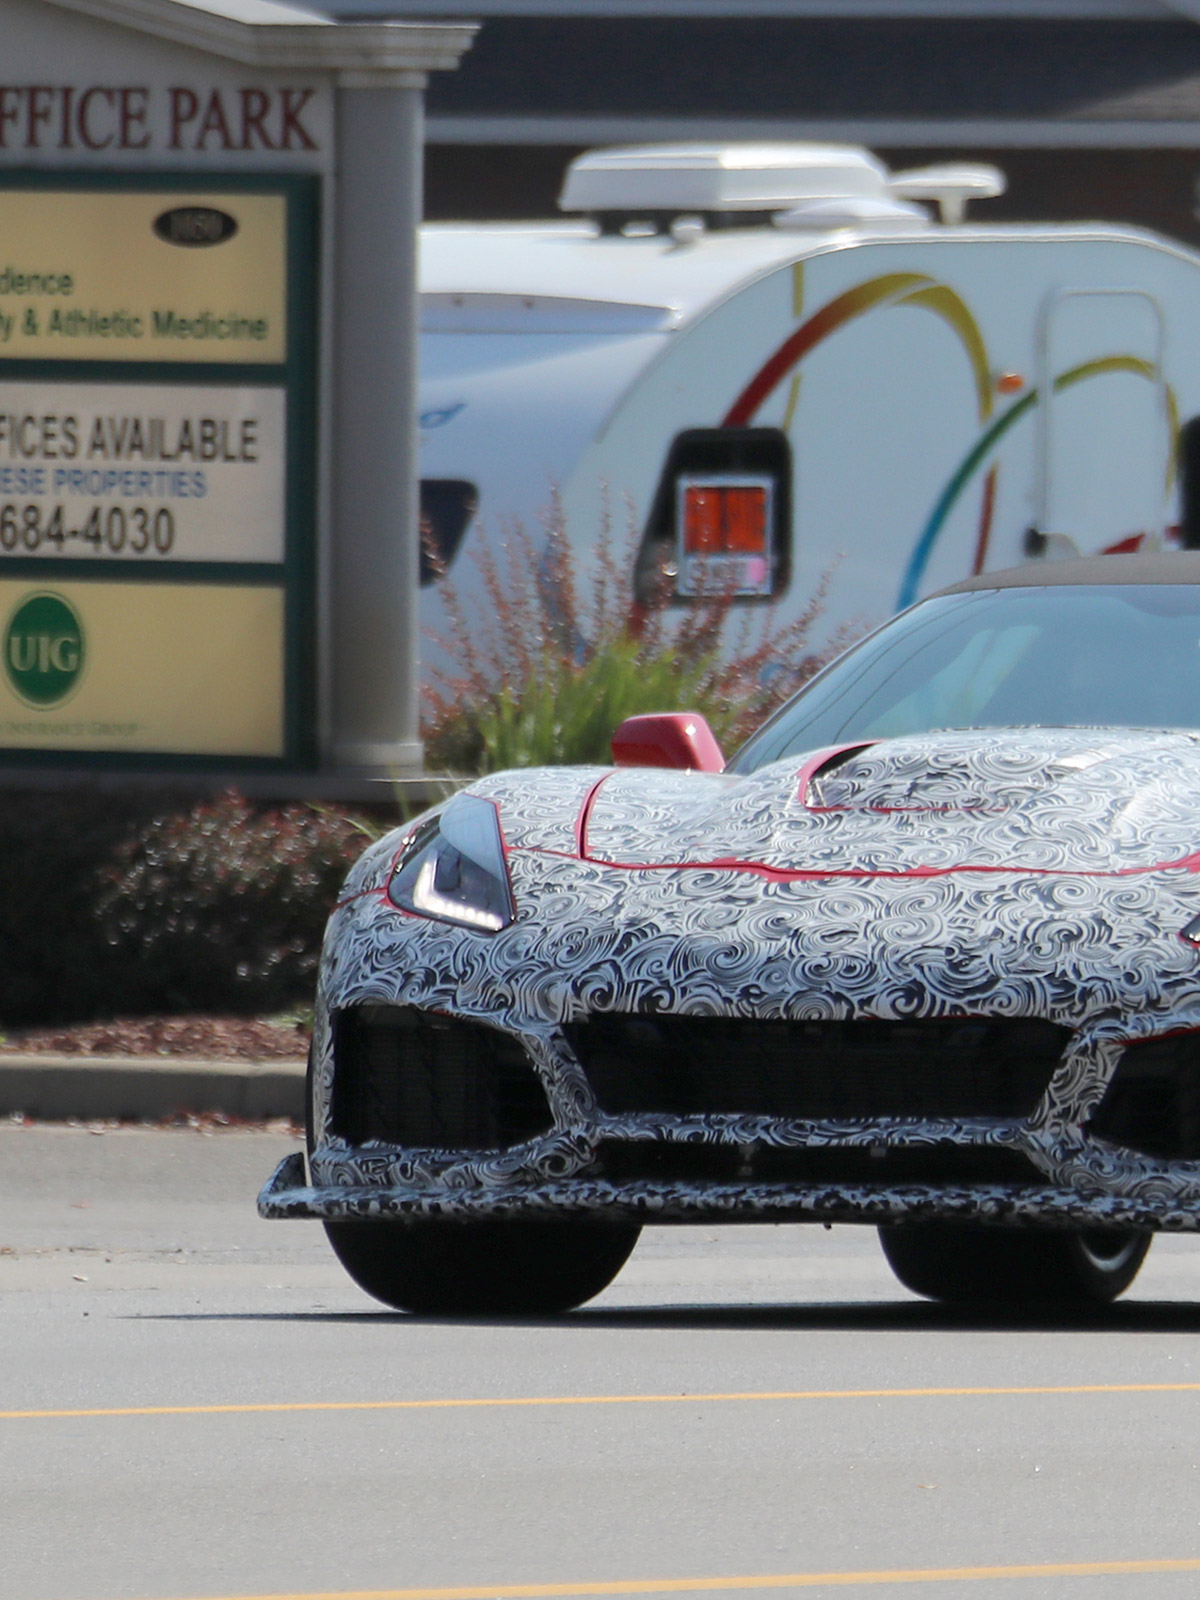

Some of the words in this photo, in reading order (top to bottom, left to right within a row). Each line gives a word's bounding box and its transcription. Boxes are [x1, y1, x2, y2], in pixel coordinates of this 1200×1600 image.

[168, 86, 319, 151] PARK
[22, 308, 38, 336] &
[48, 307, 144, 338] Athletic
[152, 310, 268, 341] Medicine
[88, 416, 259, 463] AVAILABLE
[53, 468, 207, 498] PROPERTIES
[0, 504, 175, 554] 684-4030
[9, 635, 79, 673] UIG
